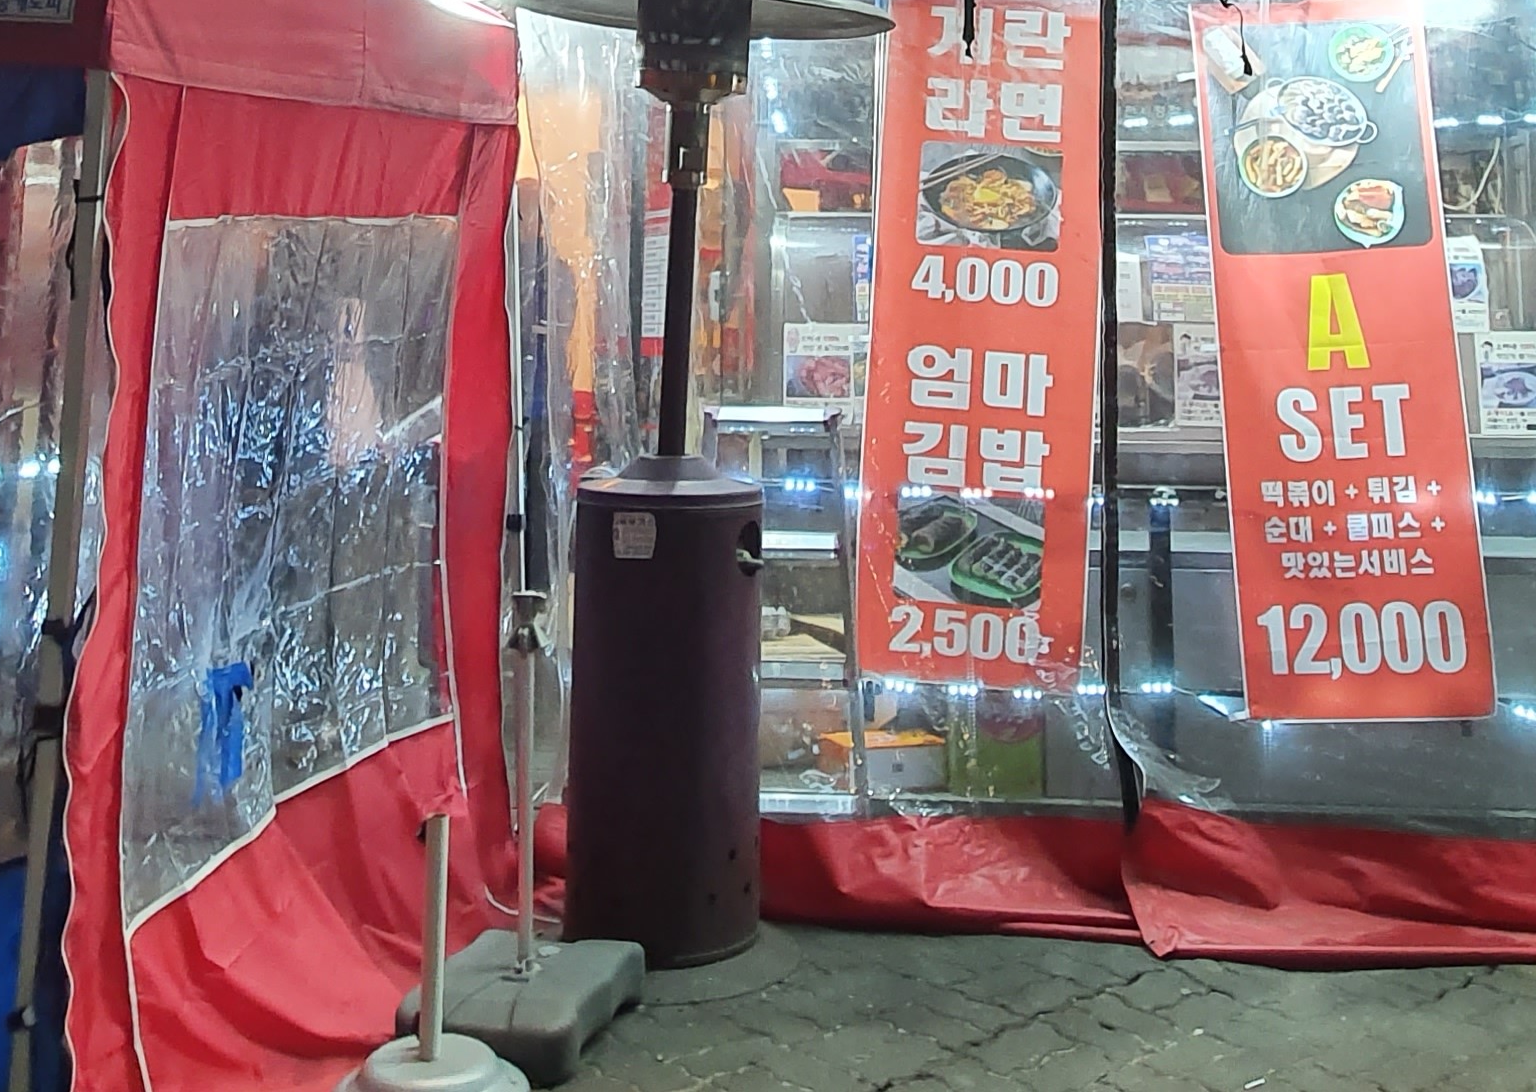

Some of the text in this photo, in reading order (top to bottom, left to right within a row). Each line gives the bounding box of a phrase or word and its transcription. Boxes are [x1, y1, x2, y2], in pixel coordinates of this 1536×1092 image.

[924, 76, 1063, 143] 라면
[911, 254, 1060, 308] 4,000
[1307, 273, 1371, 371] A
[907, 344, 1053, 417] 엄마
[902, 420, 1052, 493] 김밥
[1276, 383, 1411, 463] SET
[1260, 475, 1442, 508] 떡볶이 + 튀김 +
[1264, 516, 1313, 544] 순대
[1323, 520, 1337, 537] +
[1430, 516, 1446, 533] +
[1280, 548, 1435, 579] 맛있는서비스
[888, 604, 1043, 664] 2,500
[1256, 599, 1468, 681] 12,000
